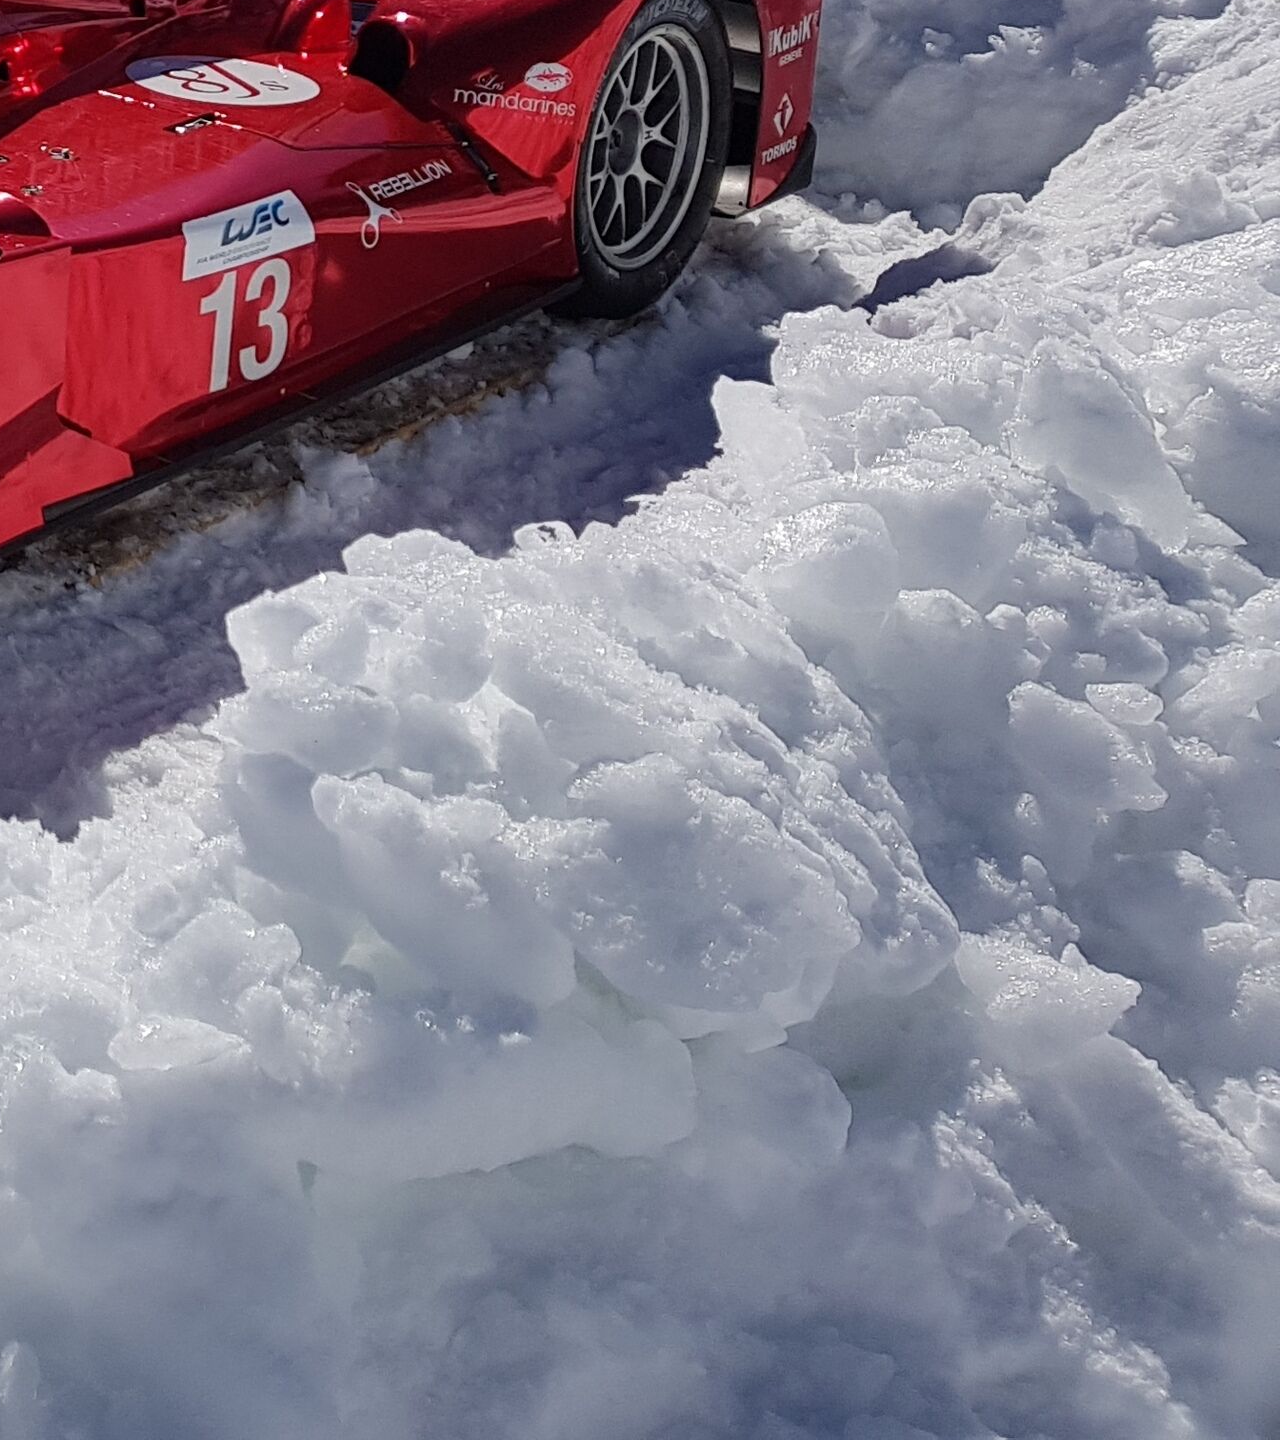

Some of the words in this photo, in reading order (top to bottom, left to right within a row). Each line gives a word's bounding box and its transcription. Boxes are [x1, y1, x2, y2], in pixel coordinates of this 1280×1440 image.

[453, 88, 577, 117] mandarines
[761, 135, 798, 165] TORNOS
[368, 159, 453, 202] REBELLION
[221, 199, 290, 246] WEC
[199, 257, 292, 393] 13
